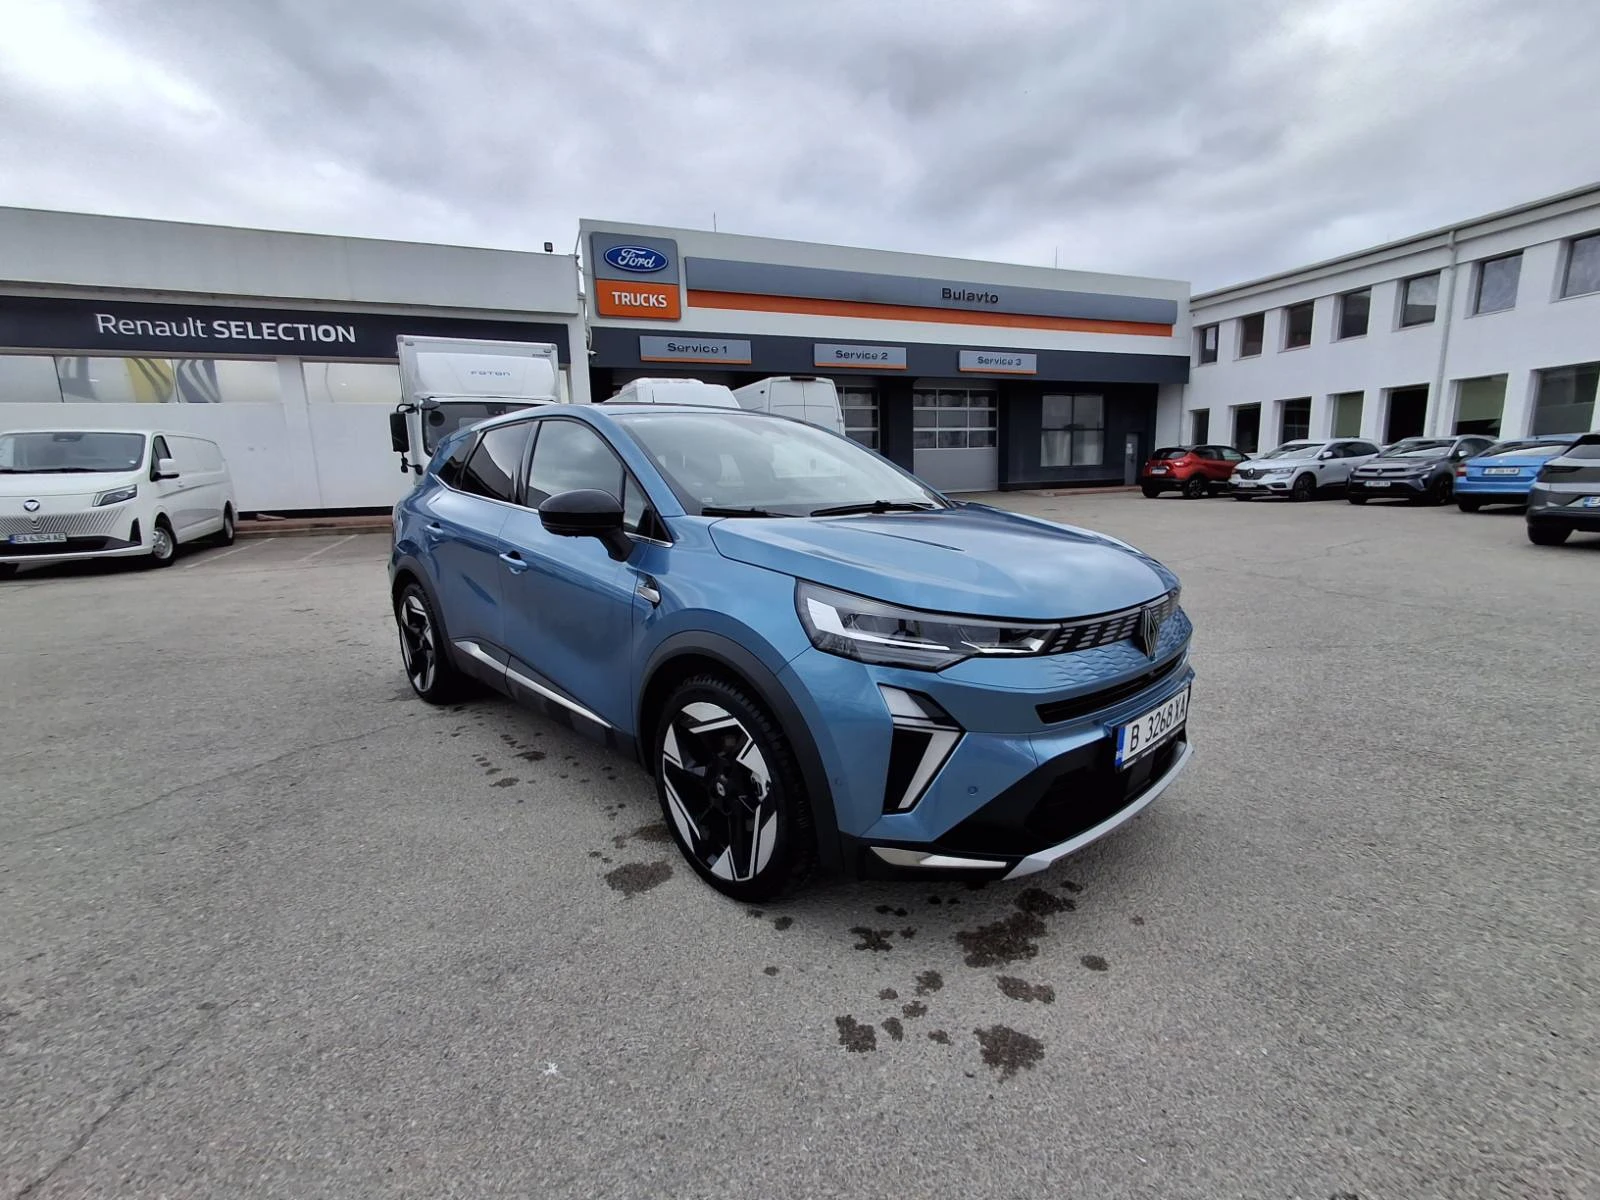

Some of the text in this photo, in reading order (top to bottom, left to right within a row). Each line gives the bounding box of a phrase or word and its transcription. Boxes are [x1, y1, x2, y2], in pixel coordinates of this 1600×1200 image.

[617, 248, 656, 268] Ford
[612, 291, 668, 308] TRUCKS
[941, 287, 999, 304] Bulavto
[94, 313, 356, 343] Renault SELECTION
[667, 342, 728, 354] Service 1
[835, 349, 888, 361] Service 2
[977, 355, 1022, 366] Service 3
[1130, 724, 1139, 752] B
[1145, 703, 1173, 742] 3268
